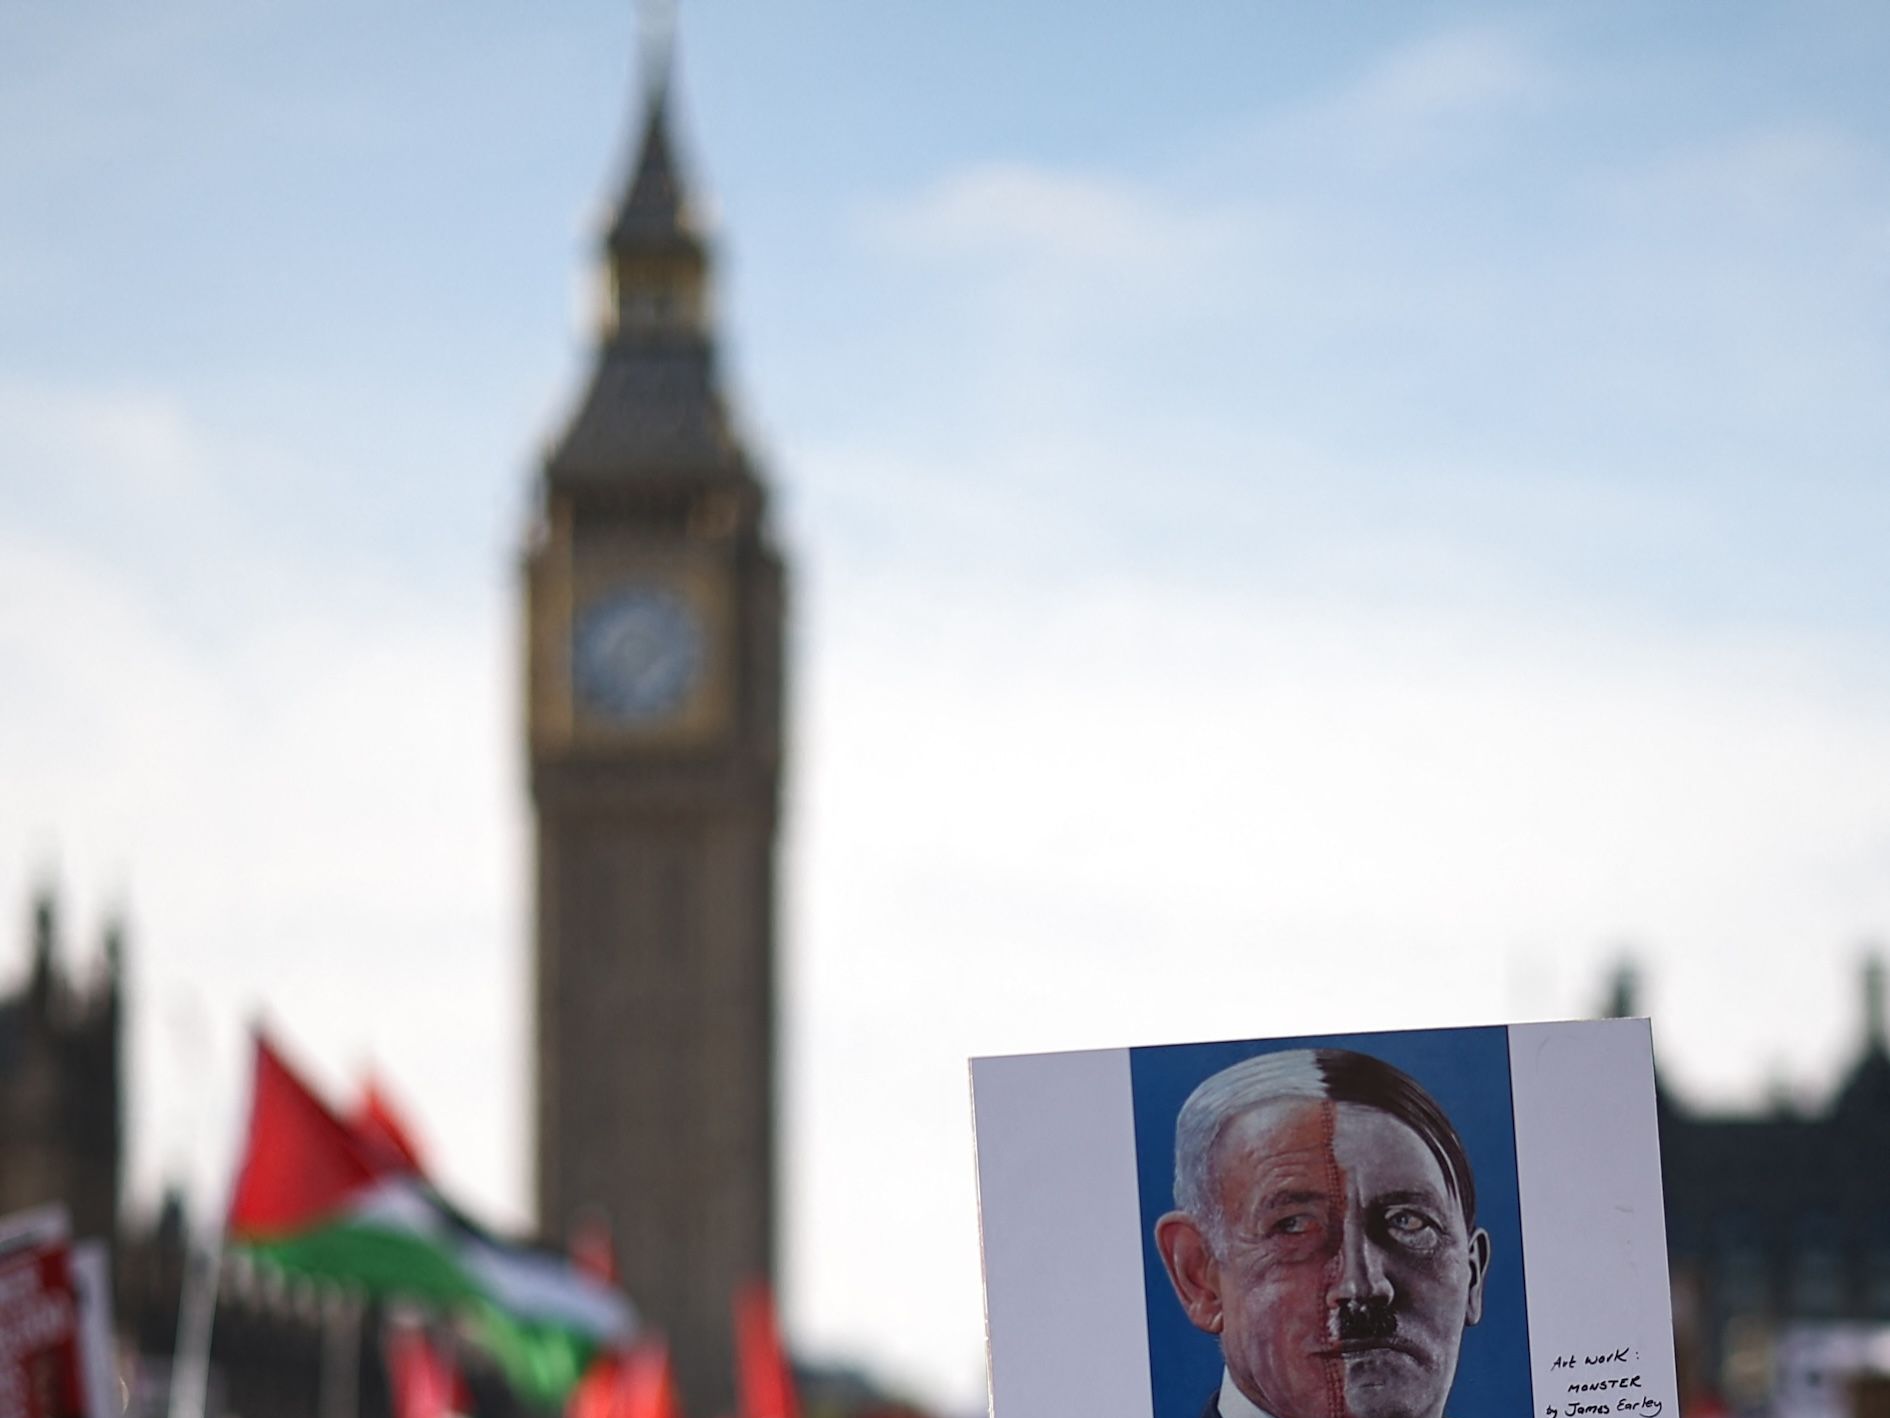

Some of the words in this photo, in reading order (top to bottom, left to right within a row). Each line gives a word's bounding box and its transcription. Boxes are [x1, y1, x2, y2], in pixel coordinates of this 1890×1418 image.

[1550, 1354, 1577, 1371] Art
[1567, 1375, 1642, 1394] MONSTER
[1564, 1402, 1610, 1417] James
[1616, 1396, 1663, 1418] Earley
